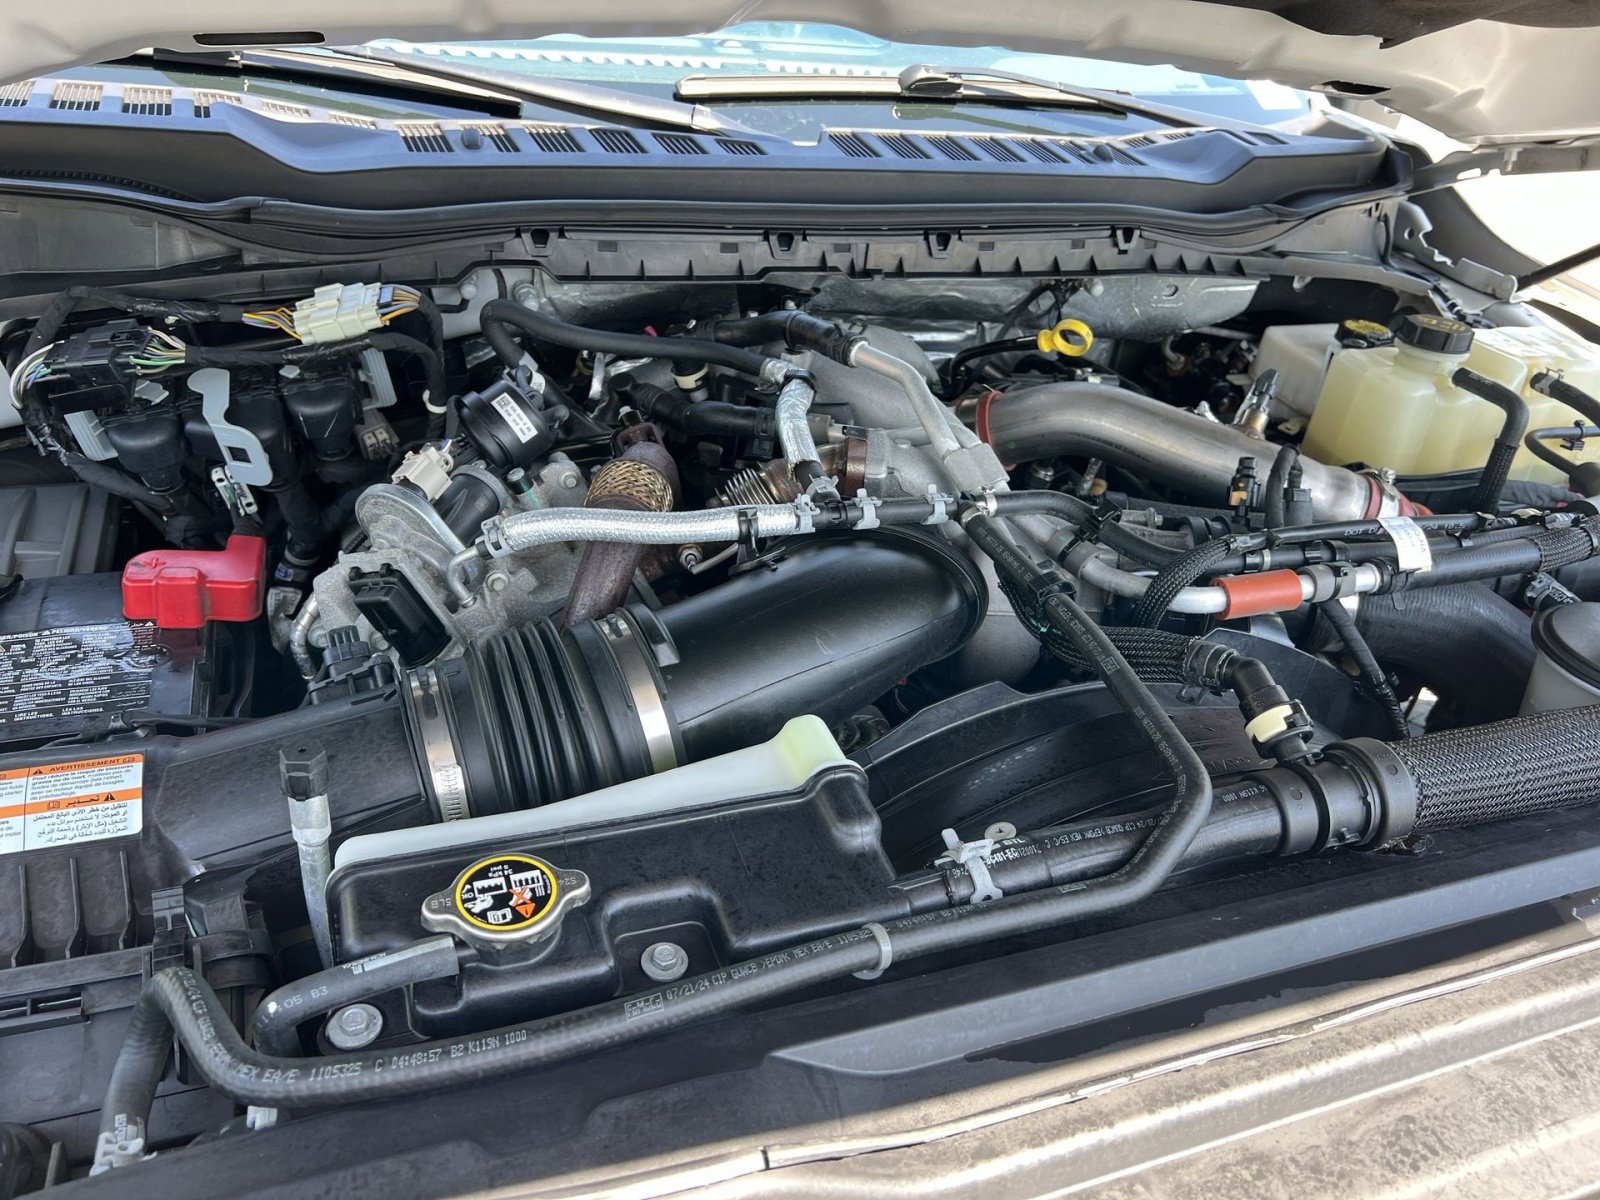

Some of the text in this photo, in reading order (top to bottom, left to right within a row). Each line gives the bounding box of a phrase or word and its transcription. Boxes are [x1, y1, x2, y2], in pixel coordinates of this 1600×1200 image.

[49, 759, 120, 772] AVERTISSEMENT
[310, 985, 329, 999] B3
[665, 980, 710, 1001] 07/21/24
[262, 1068, 300, 1083] EA/E
[374, 1058, 383, 1073] C
[391, 1048, 443, 1070] 04:48:57
[450, 1043, 464, 1059] B2
